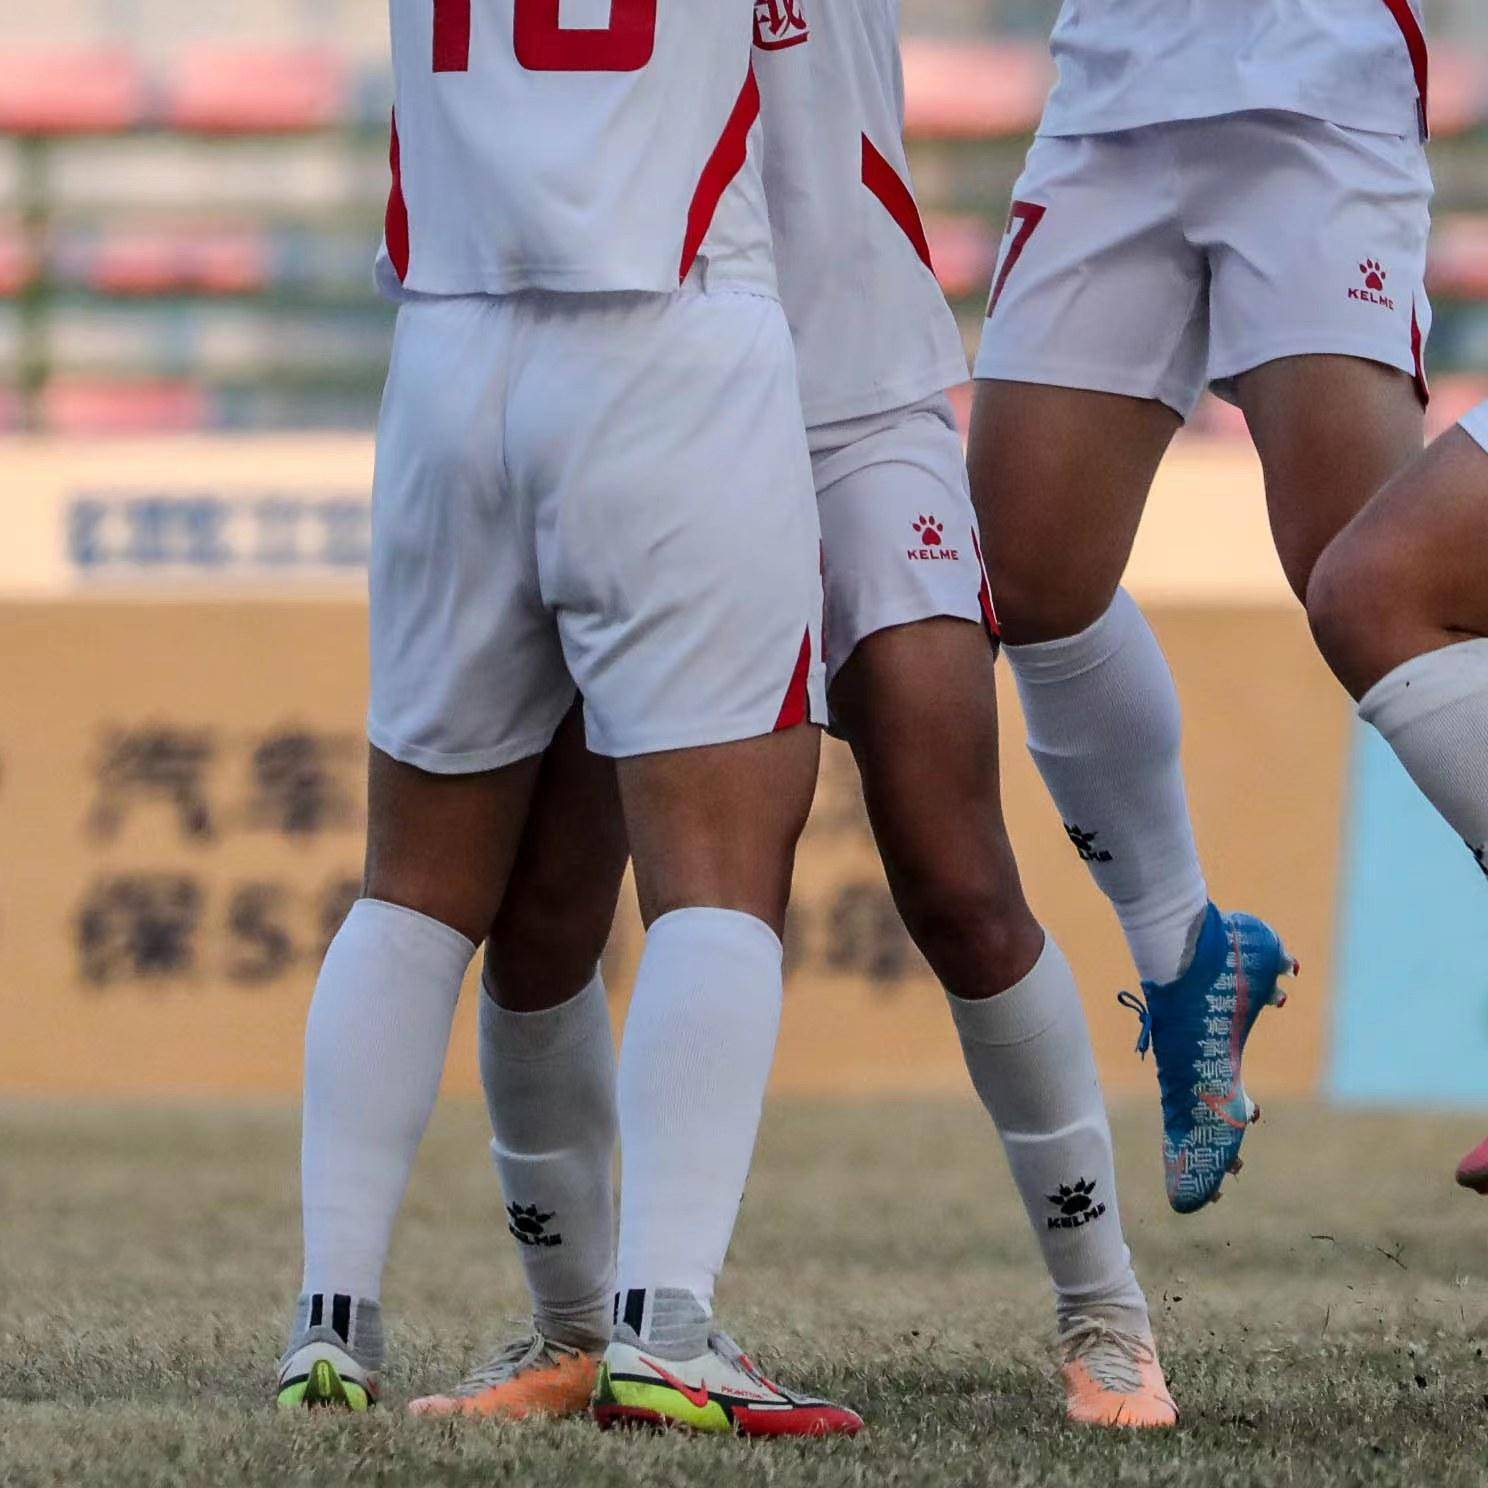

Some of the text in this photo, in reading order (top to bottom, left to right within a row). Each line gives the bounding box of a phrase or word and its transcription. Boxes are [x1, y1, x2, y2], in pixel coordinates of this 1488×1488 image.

[1347, 287, 1394, 311] KELME
[907, 549, 959, 560] KELME
[1047, 1202, 1106, 1229] KELME
